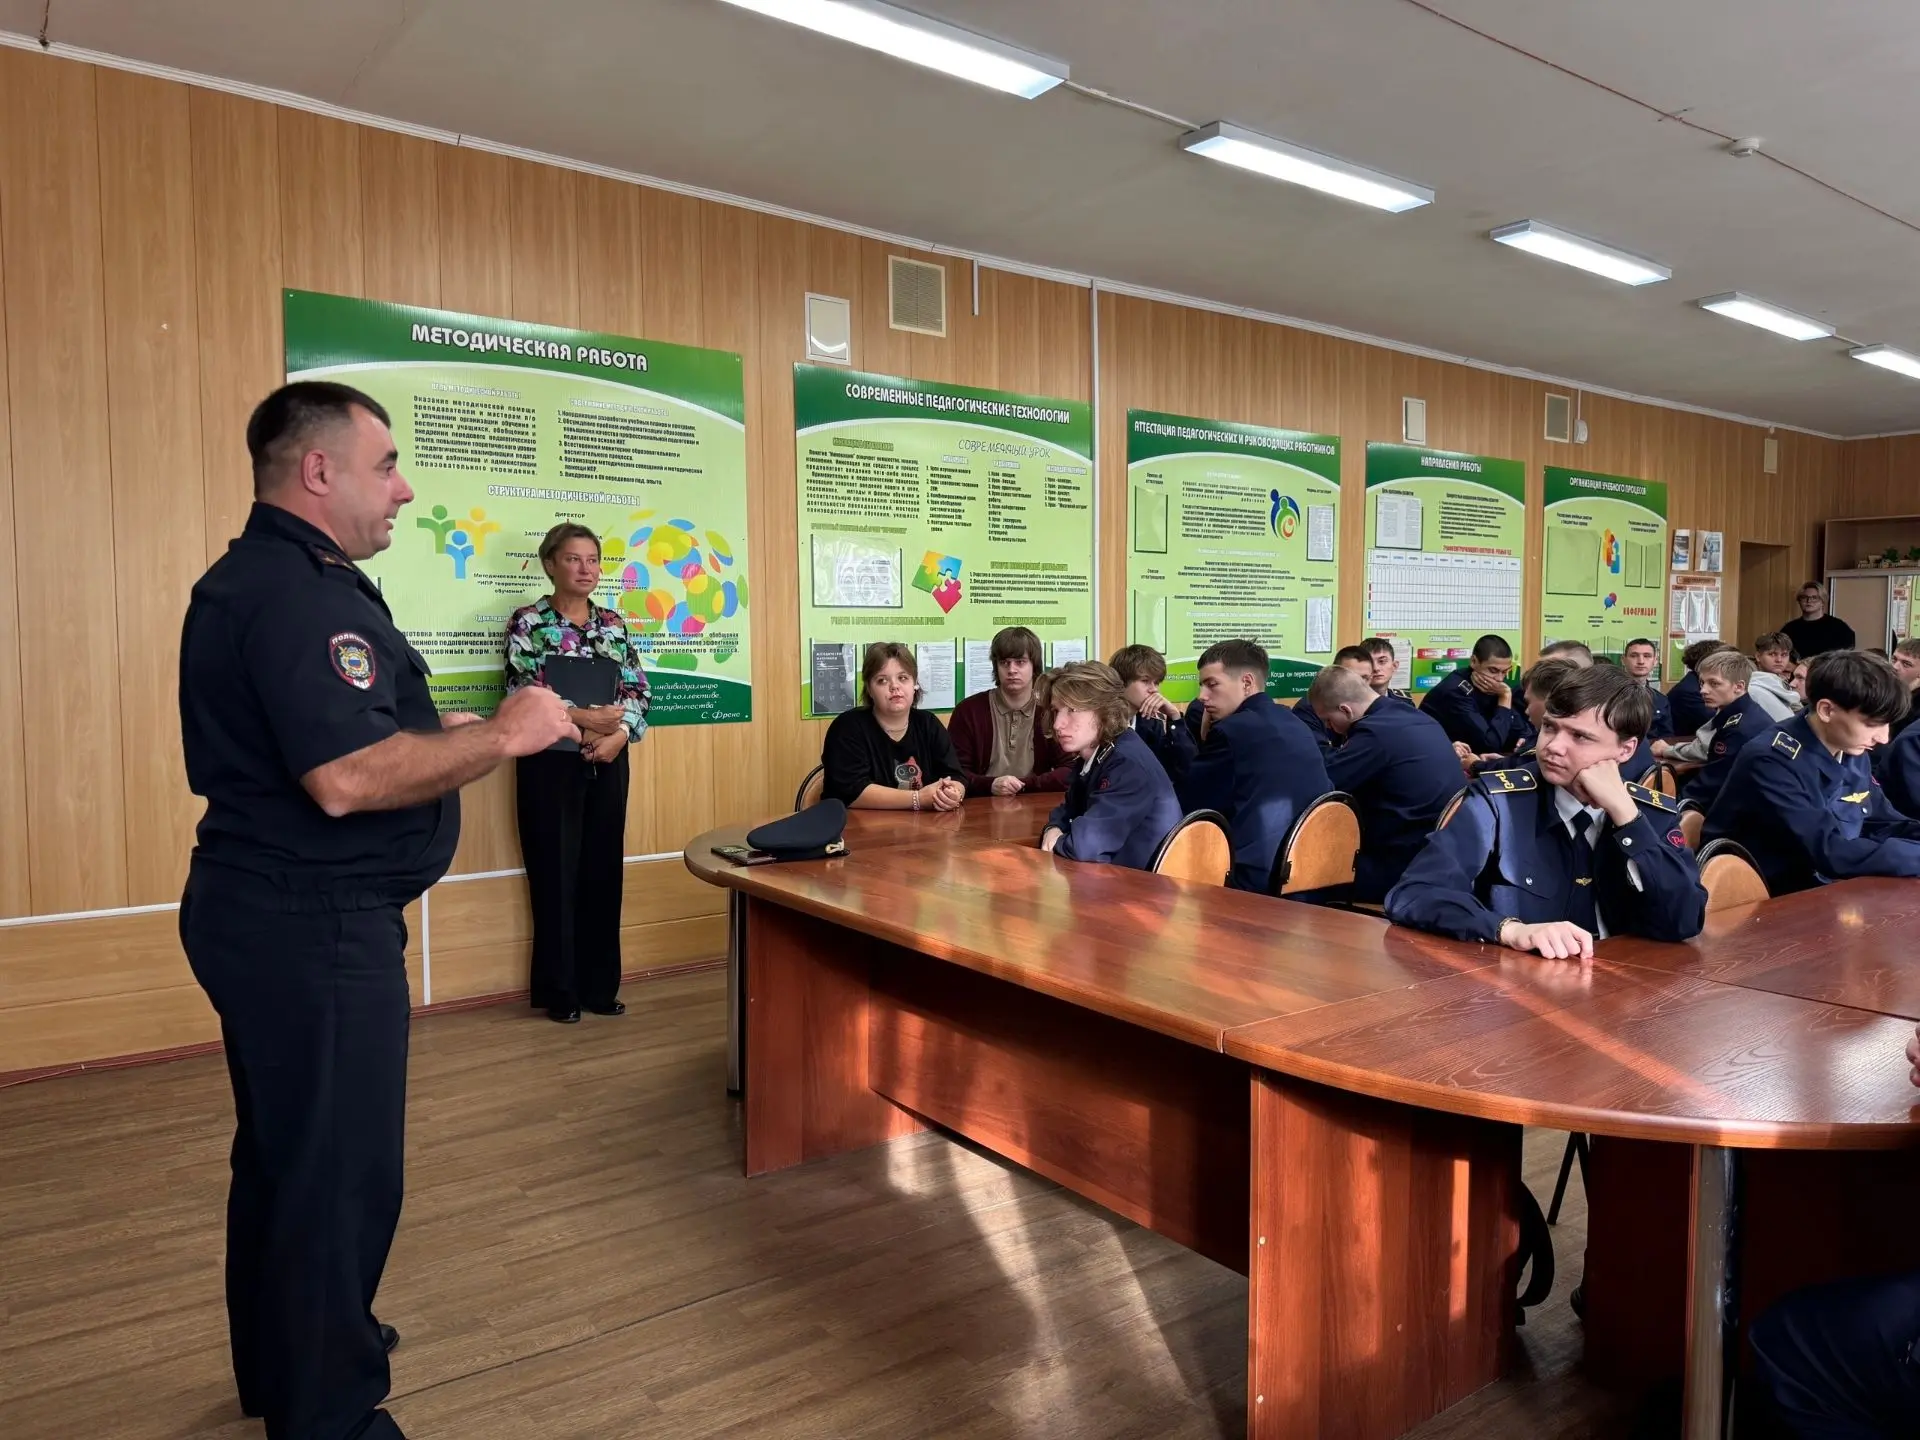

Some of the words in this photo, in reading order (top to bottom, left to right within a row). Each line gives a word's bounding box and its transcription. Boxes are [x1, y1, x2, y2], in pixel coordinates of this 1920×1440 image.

[411, 323, 572, 362] МЕТОДИЧЕСКАЯ
[576, 346, 649, 372] РАБОТА
[846, 383, 924, 408] СОВРЕМЕННЫЕ
[926, 395, 1010, 418] ПЕДАГОГИЧЕСКИЕ
[1011, 404, 1070, 424] ТЕХНОЛОГИИ
[1134, 420, 1176, 438] АТТЕСТАЦИЯ
[1177, 426, 1238, 445] ПЕДАГОГИЧЕСКИХ
[1239, 434, 1244, 444] И
[1244, 435, 1294, 452] РУКОВОДЯЩИХ
[1294, 440, 1335, 455] РАБОТНИКОВ
[1029, 447, 1051, 458] УРОК
[1421, 456, 1459, 470] НАПРАВЛЕНИЯ
[1460, 461, 1482, 473] РАБОТЫ
[1570, 477, 1602, 489] ОРГАНИЗАЦИЯ
[488, 485, 537, 499] СТРУКТУРА
[537, 490, 605, 504] МЕТОДИЧЕСКОЙ
[606, 495, 640, 506] РАБОТЫ
